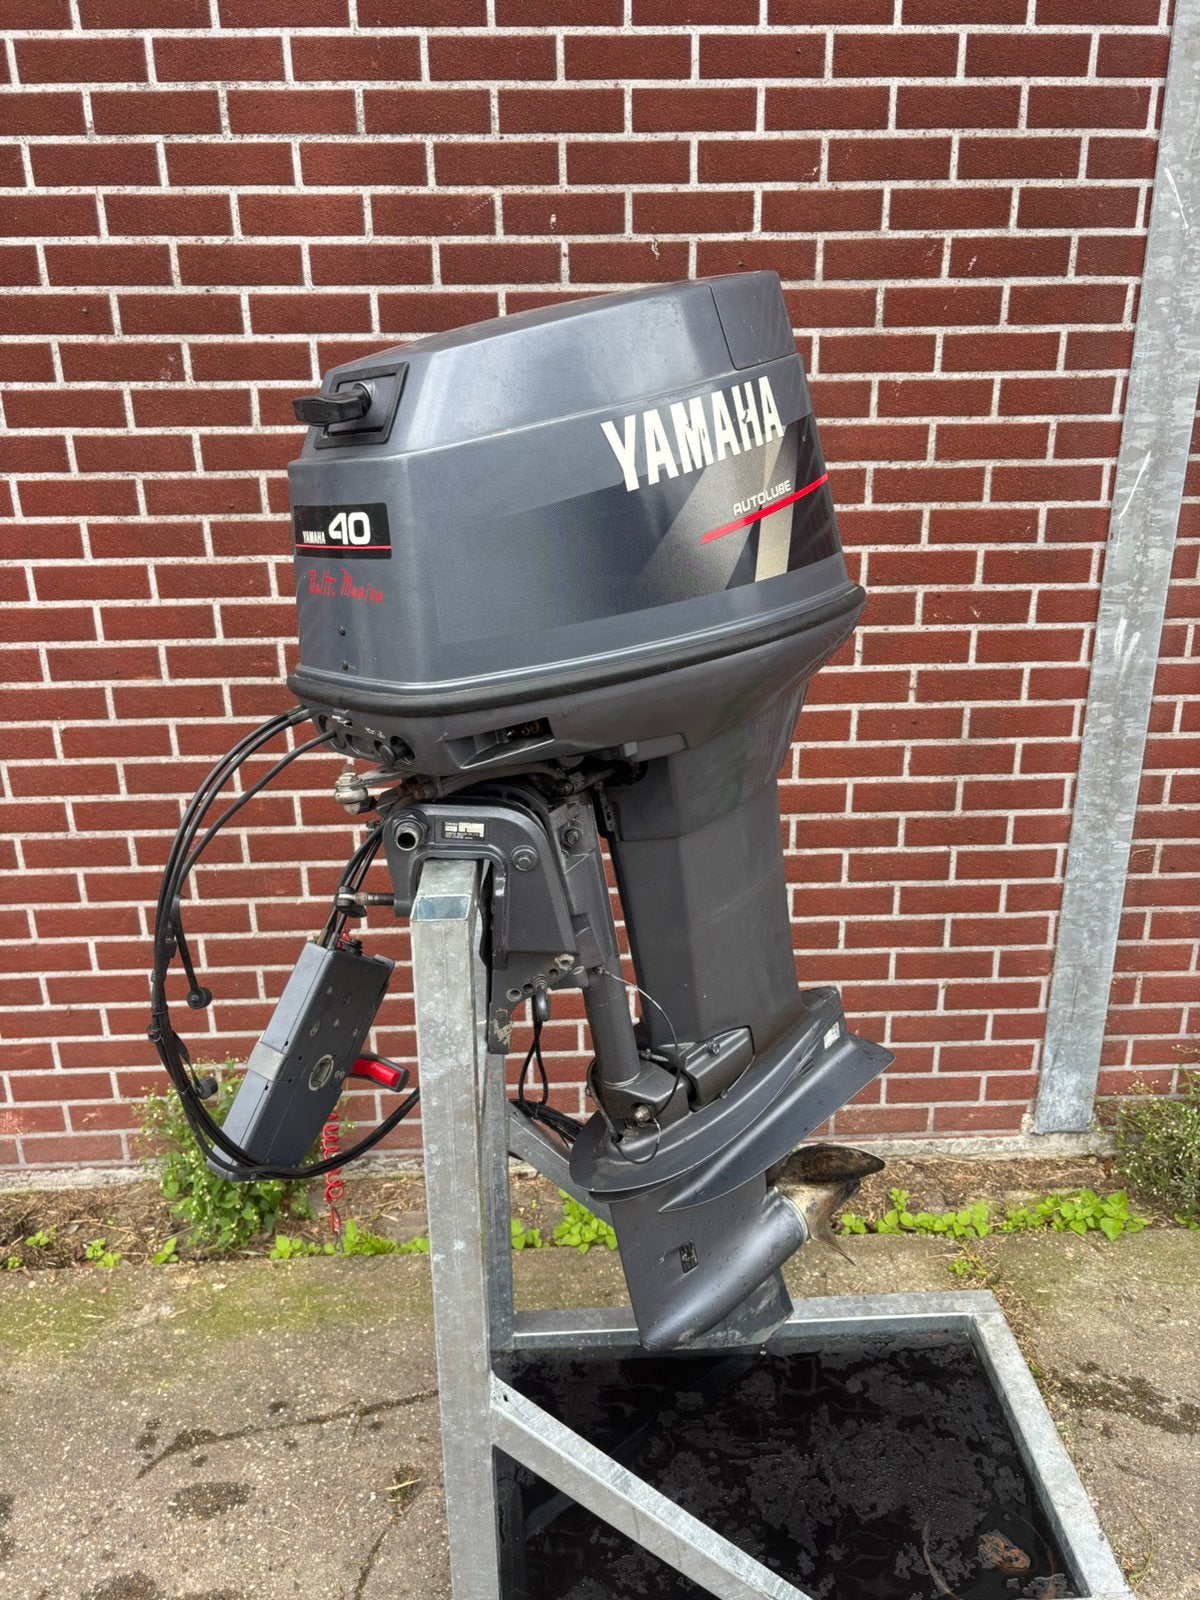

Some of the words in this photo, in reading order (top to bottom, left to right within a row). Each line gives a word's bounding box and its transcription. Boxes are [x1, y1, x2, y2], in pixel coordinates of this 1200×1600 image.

[600, 376, 785, 492] YAMAHA
[733, 479, 792, 516] AUTOLUBE
[302, 530, 326, 545] YAMAHA
[328, 511, 371, 545] 40
